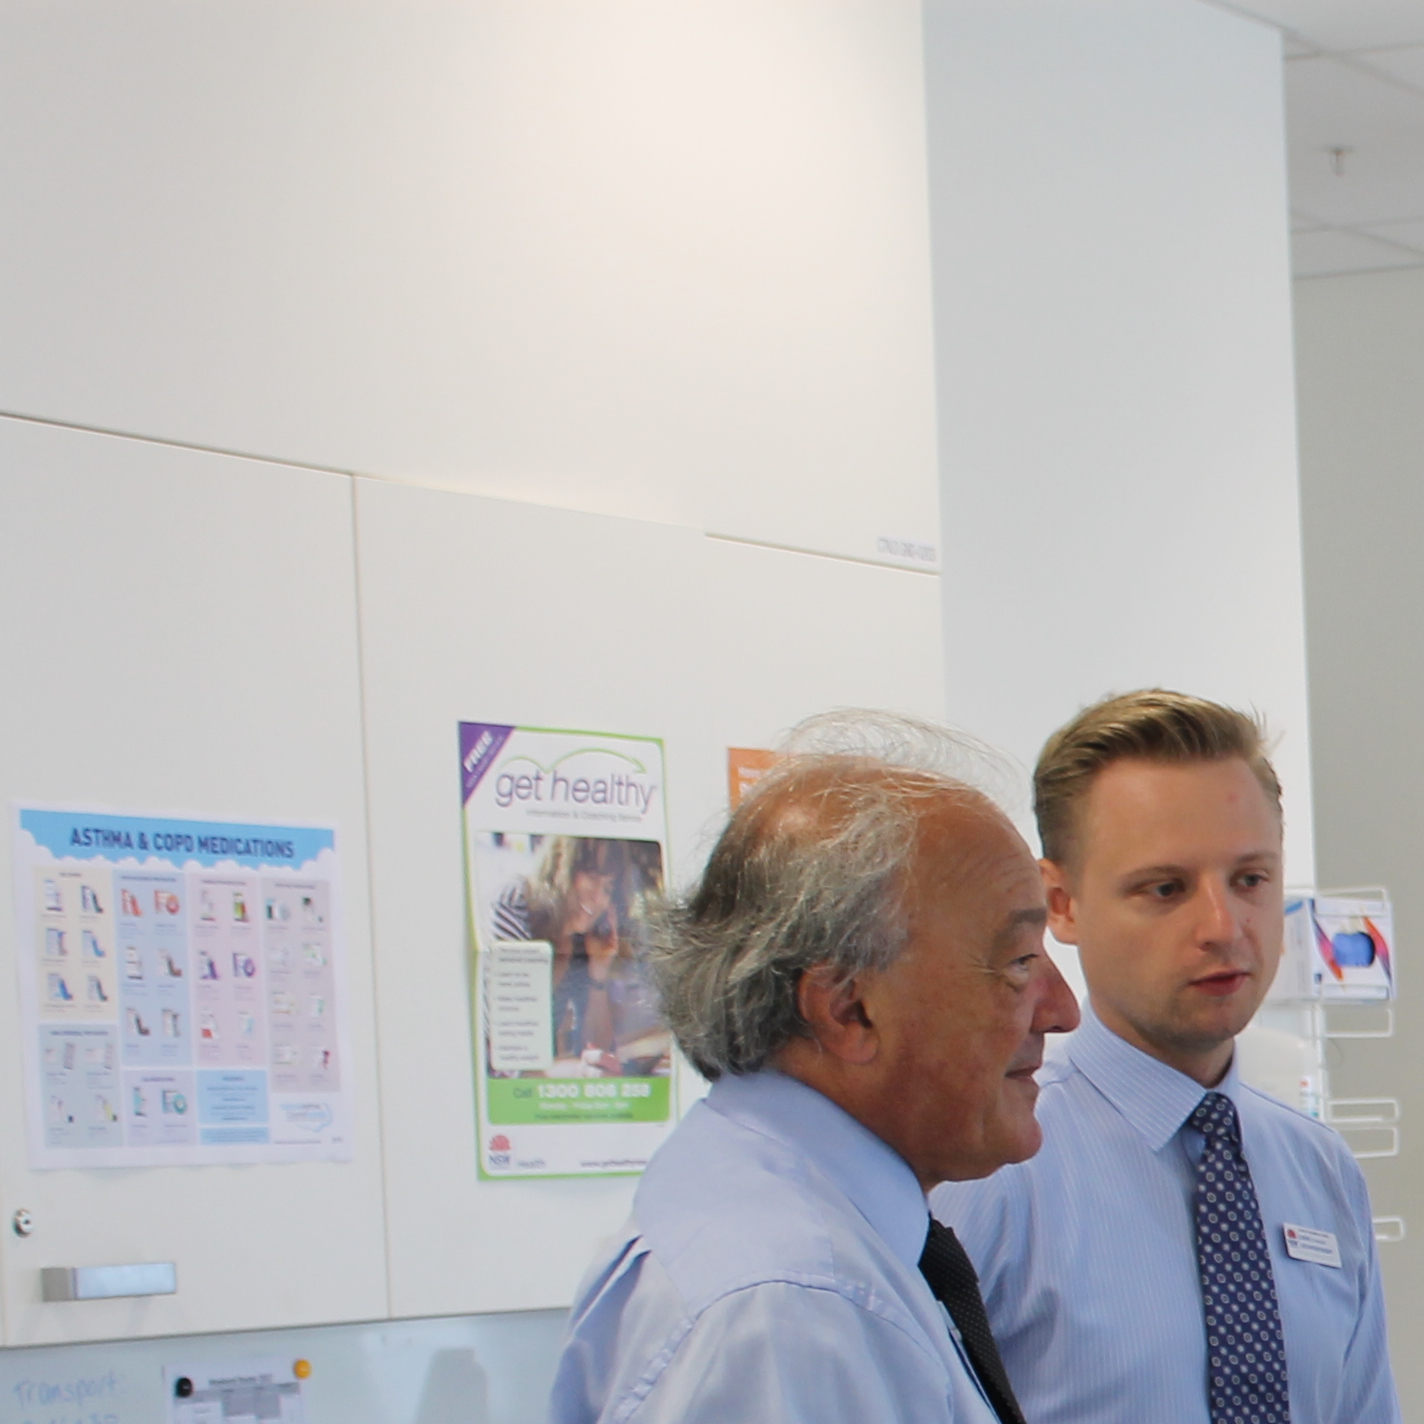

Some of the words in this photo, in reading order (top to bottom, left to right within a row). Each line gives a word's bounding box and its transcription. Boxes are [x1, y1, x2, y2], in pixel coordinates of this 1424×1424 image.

[463, 731, 494, 773] FREE
[495, 770, 543, 807] get
[551, 769, 655, 814] healthy
[70, 827, 134, 850] ASTHMA
[139, 831, 149, 851] &
[154, 832, 195, 853] COPD
[198, 835, 295, 858] MEDICATIONS
[538, 1083, 579, 1098] 1300
